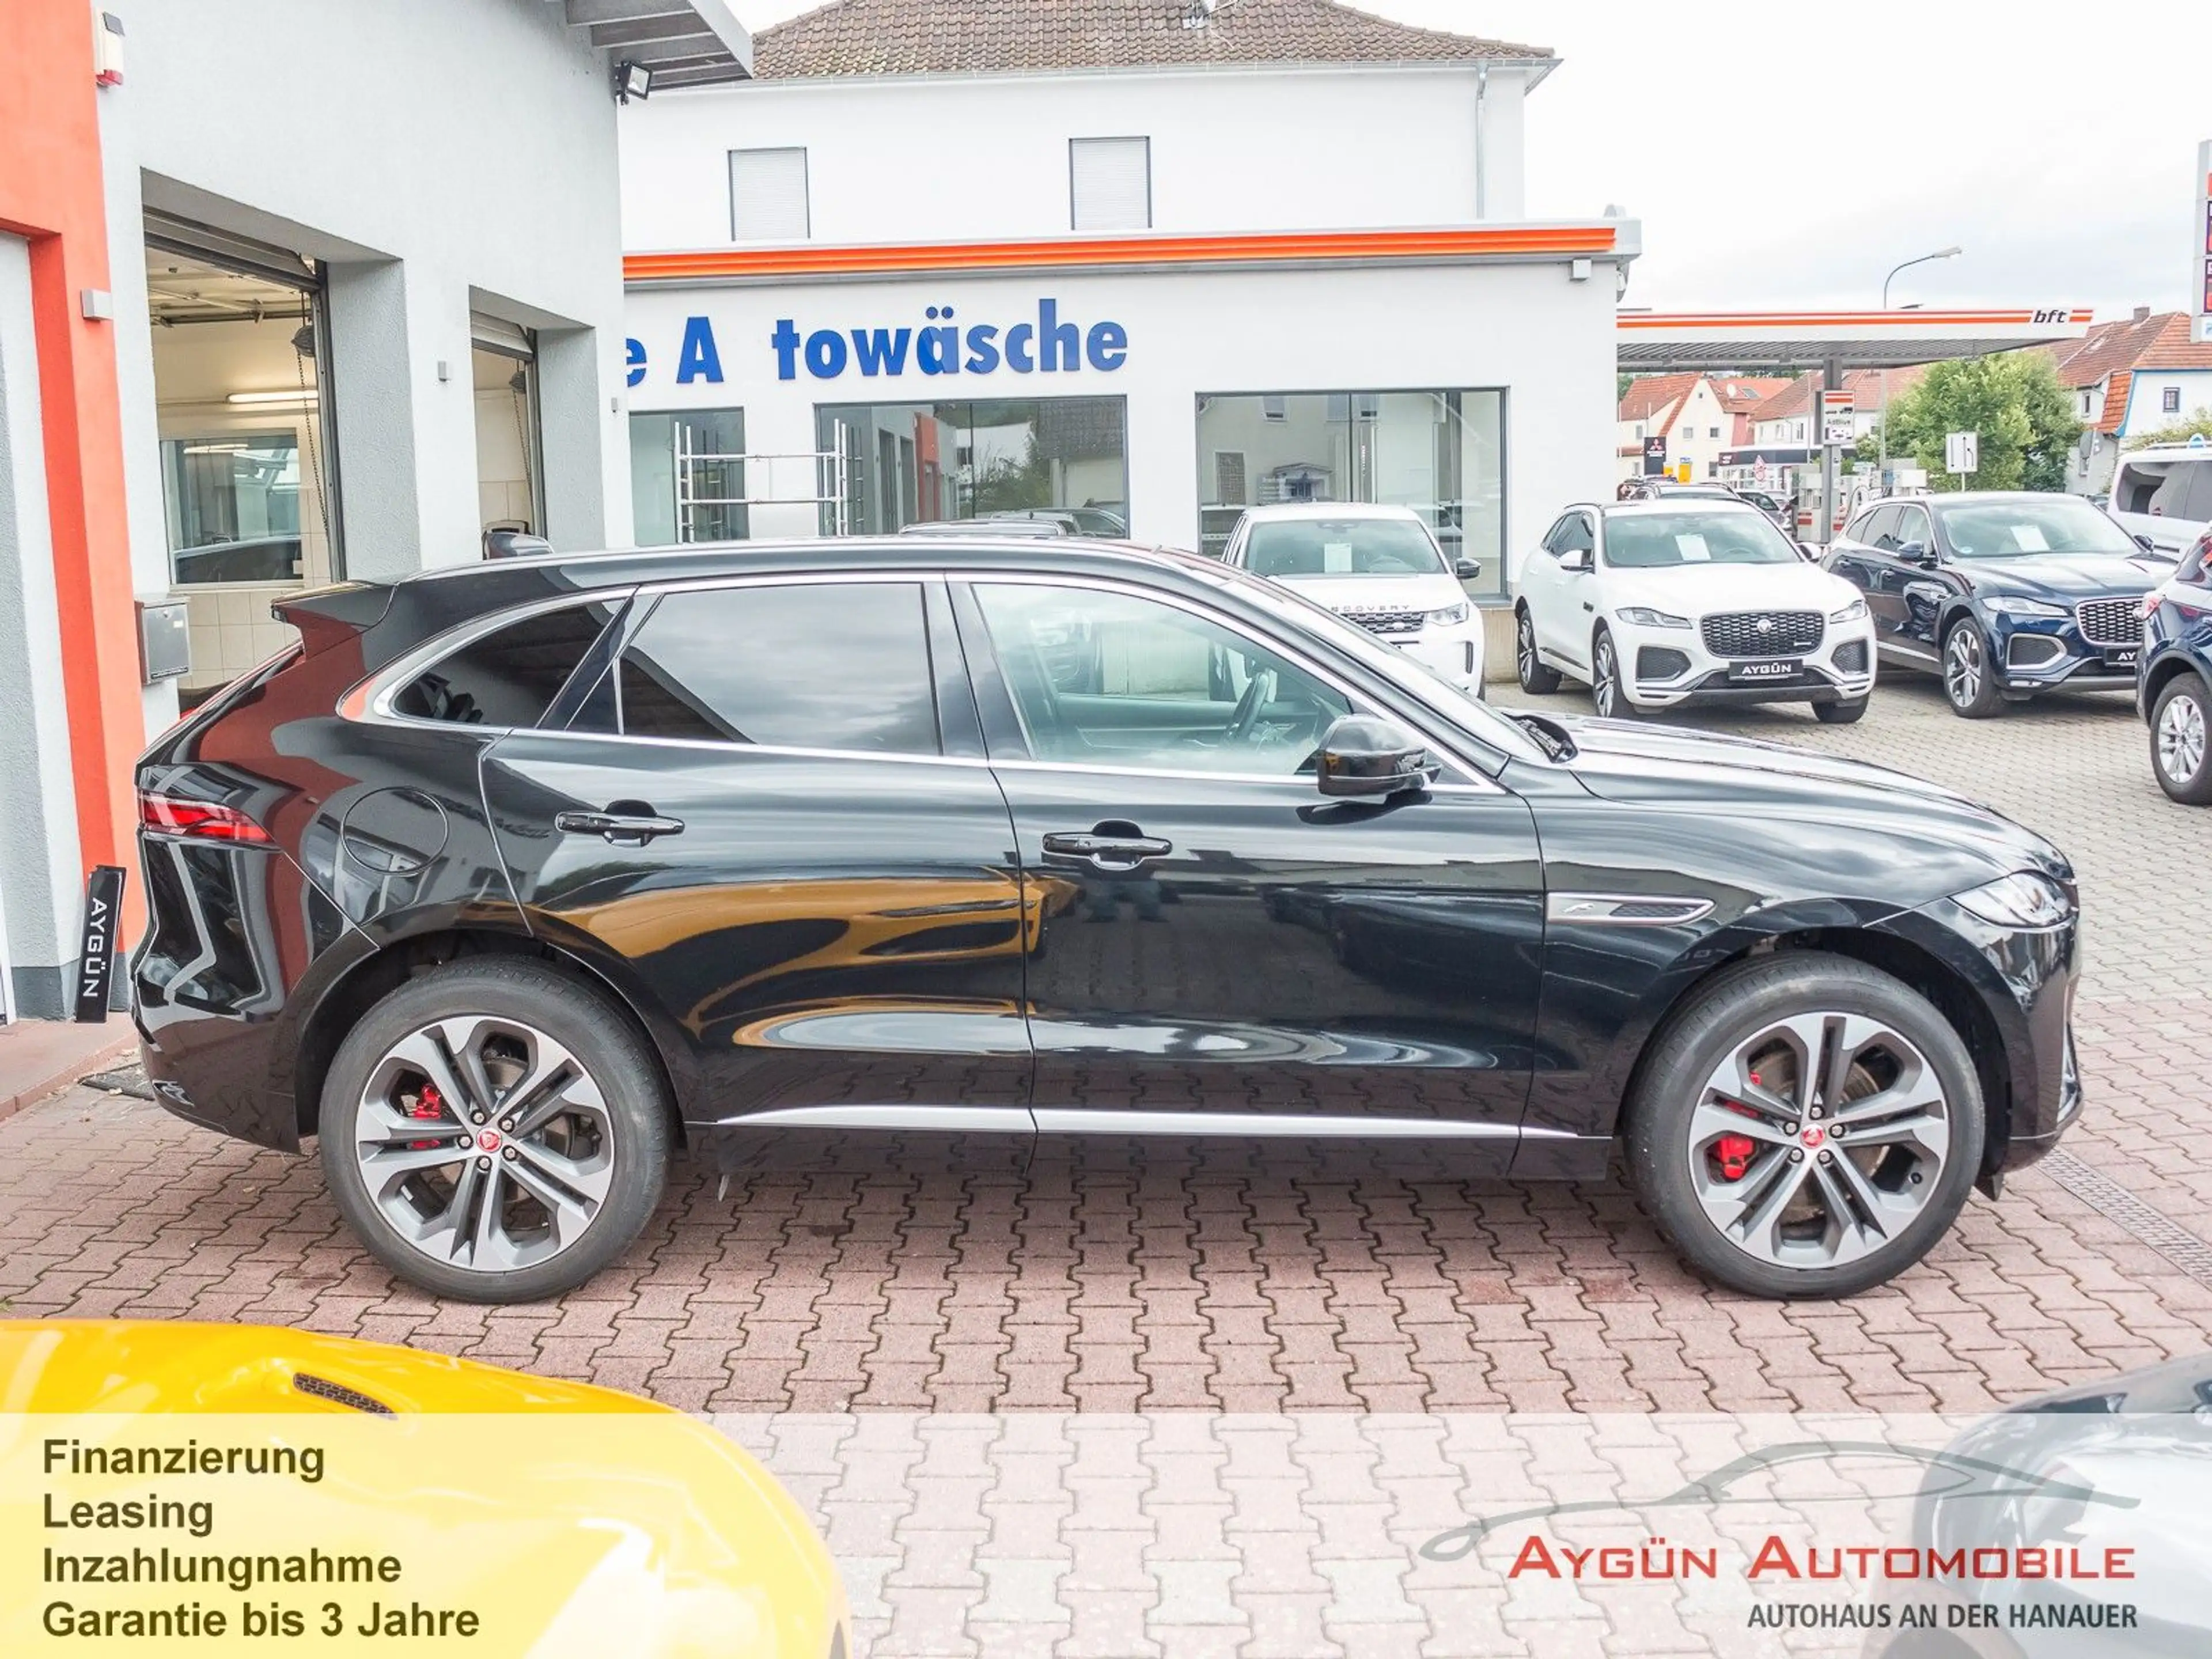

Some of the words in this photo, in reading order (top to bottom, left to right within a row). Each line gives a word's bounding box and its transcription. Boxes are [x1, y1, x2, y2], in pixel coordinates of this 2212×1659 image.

[2033, 309, 2067, 323] bft
[1741, 662, 1791, 675] AYGÜN
[83, 897, 108, 998] AYGÜN
